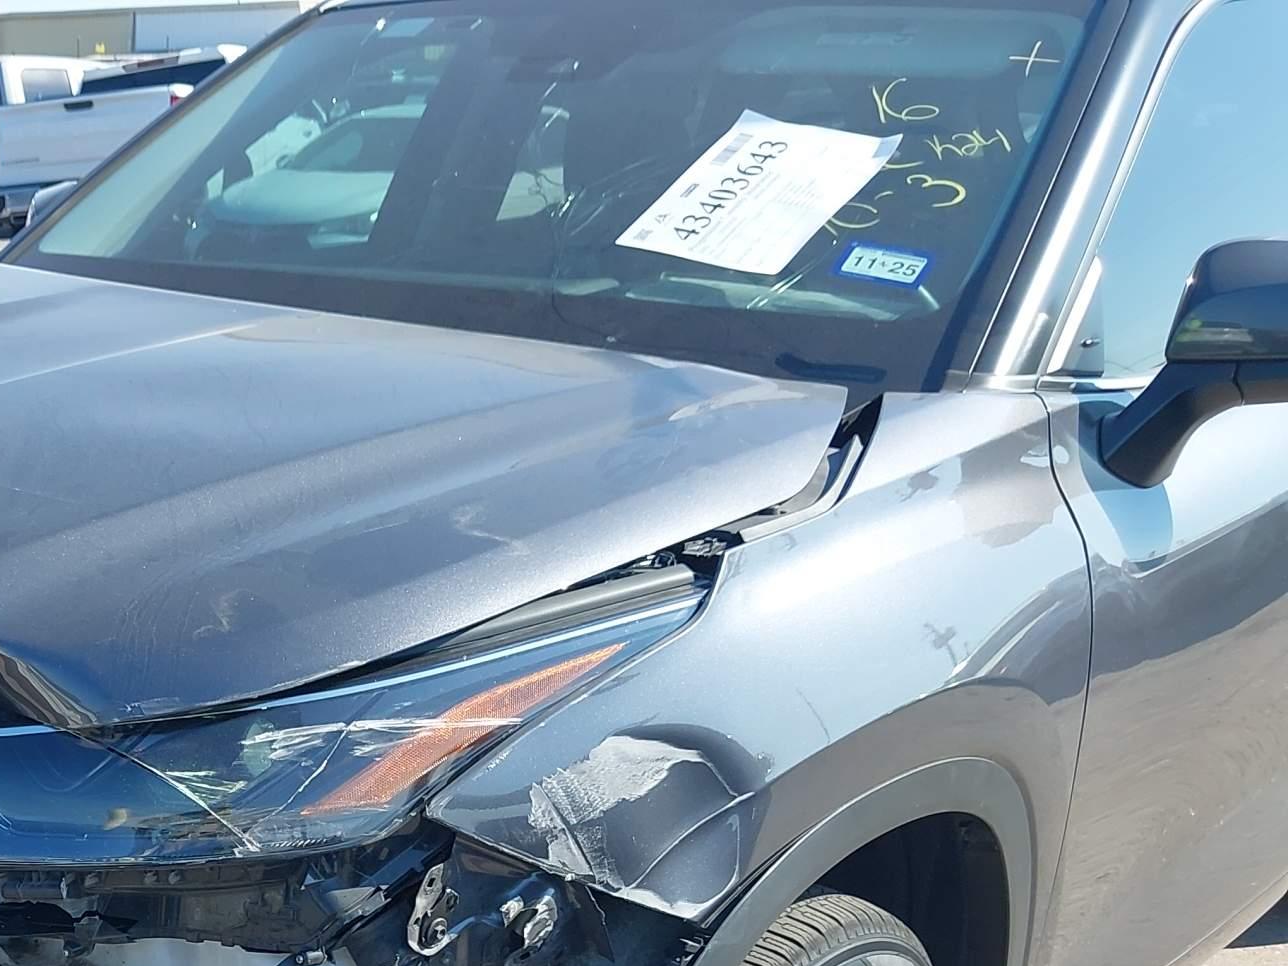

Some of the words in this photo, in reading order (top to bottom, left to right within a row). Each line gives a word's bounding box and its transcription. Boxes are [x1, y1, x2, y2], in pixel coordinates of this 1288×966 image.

[871, 77, 940, 124] 16
[673, 140, 789, 242] 43403643
[887, 261, 920, 277] 25
